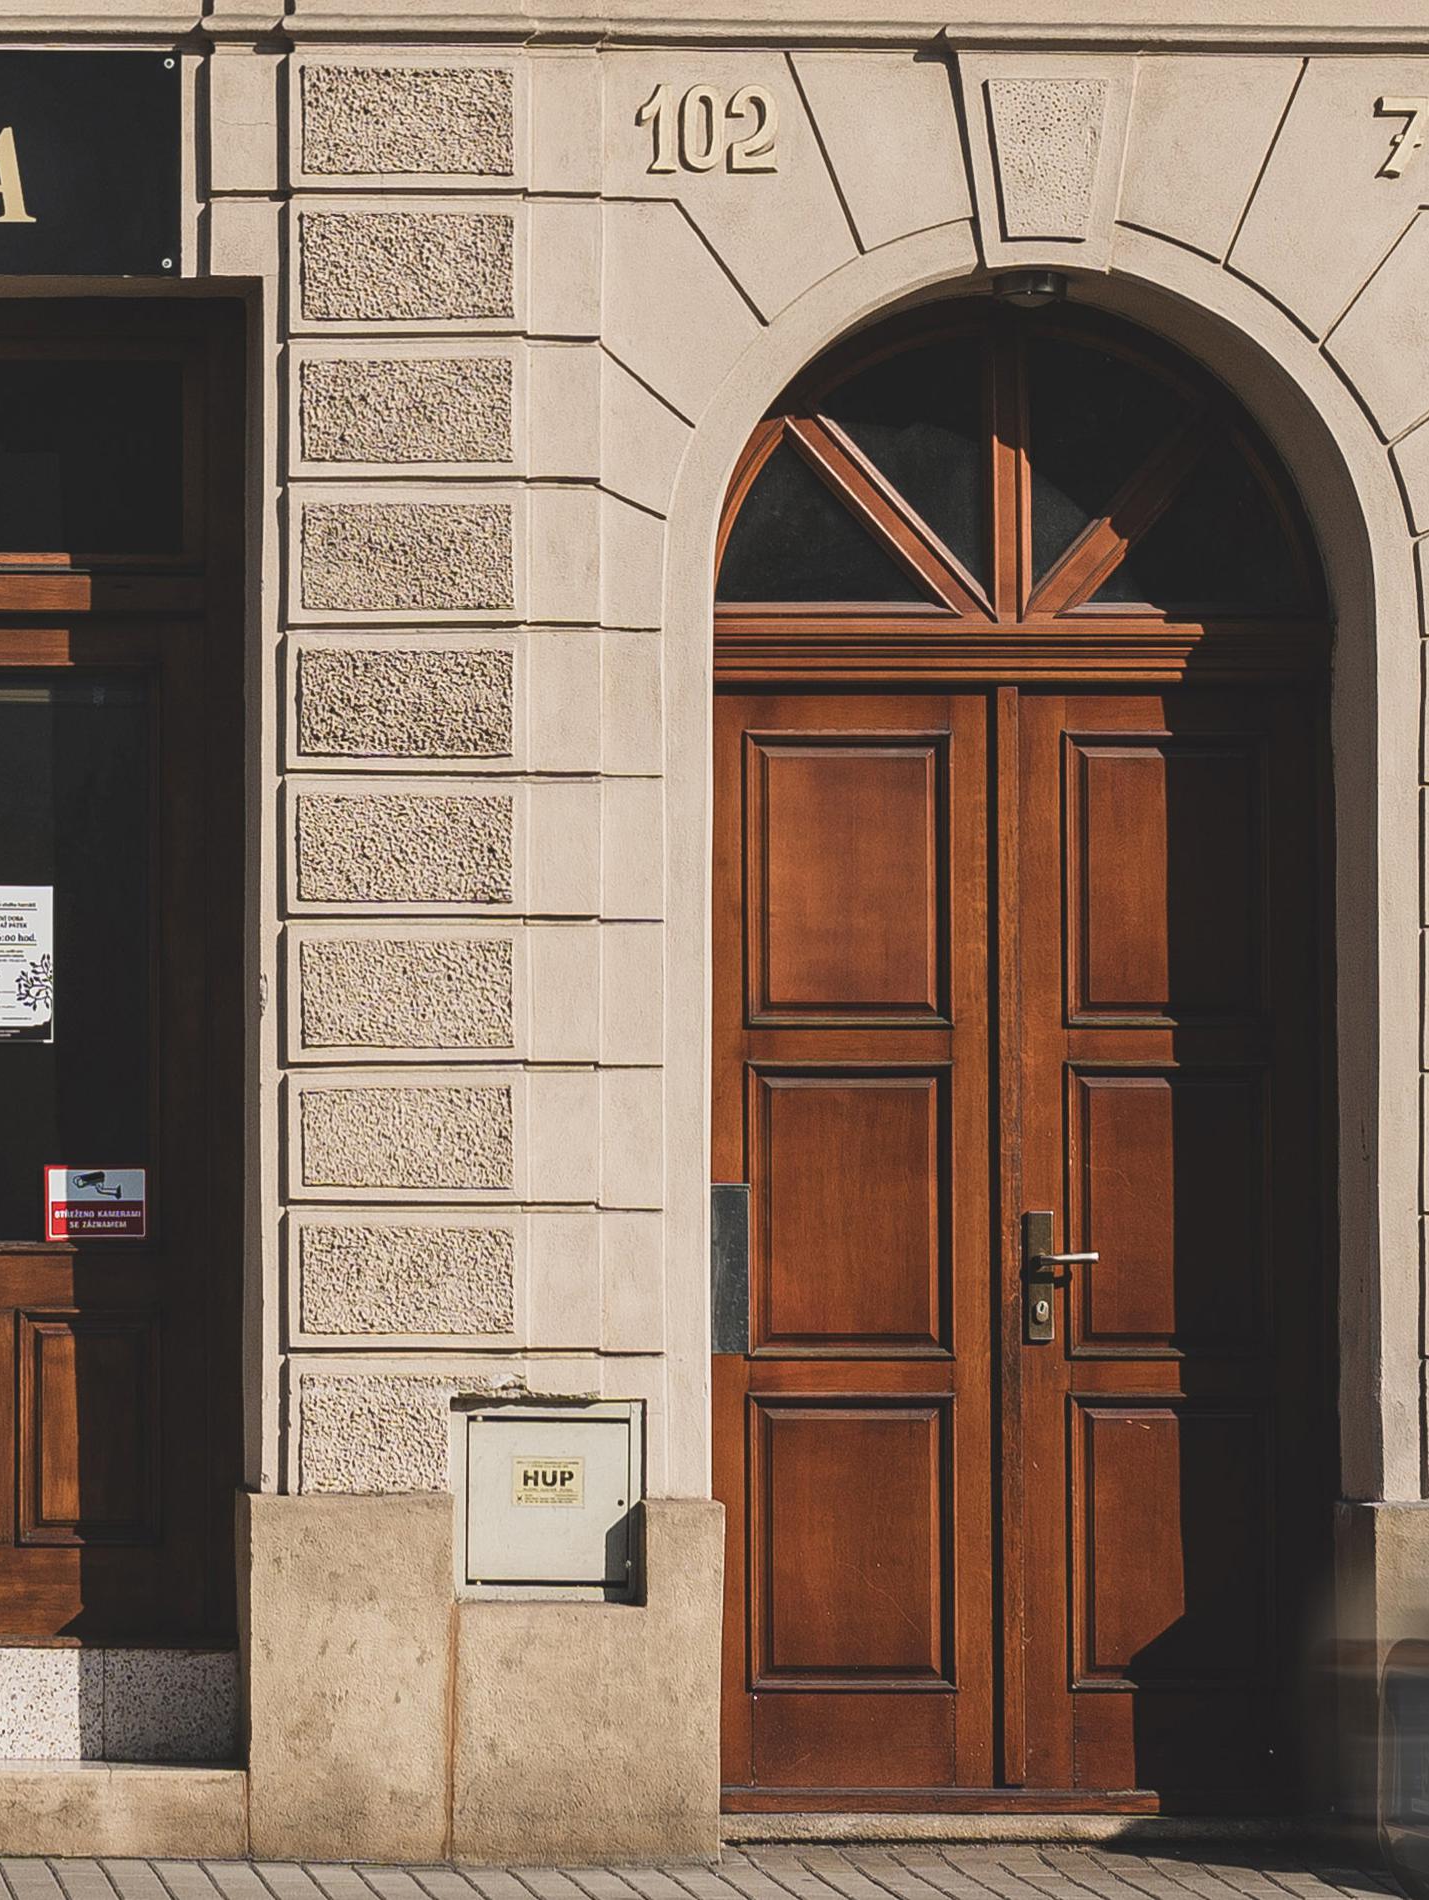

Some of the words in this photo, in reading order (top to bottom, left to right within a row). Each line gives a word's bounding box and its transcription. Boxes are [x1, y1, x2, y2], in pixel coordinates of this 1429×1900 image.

[634, 84, 779, 174] 102
[97, 1209, 142, 1218] KAMERAMI
[69, 1219, 80, 1229] SE
[523, 1470, 574, 1487] HUP
